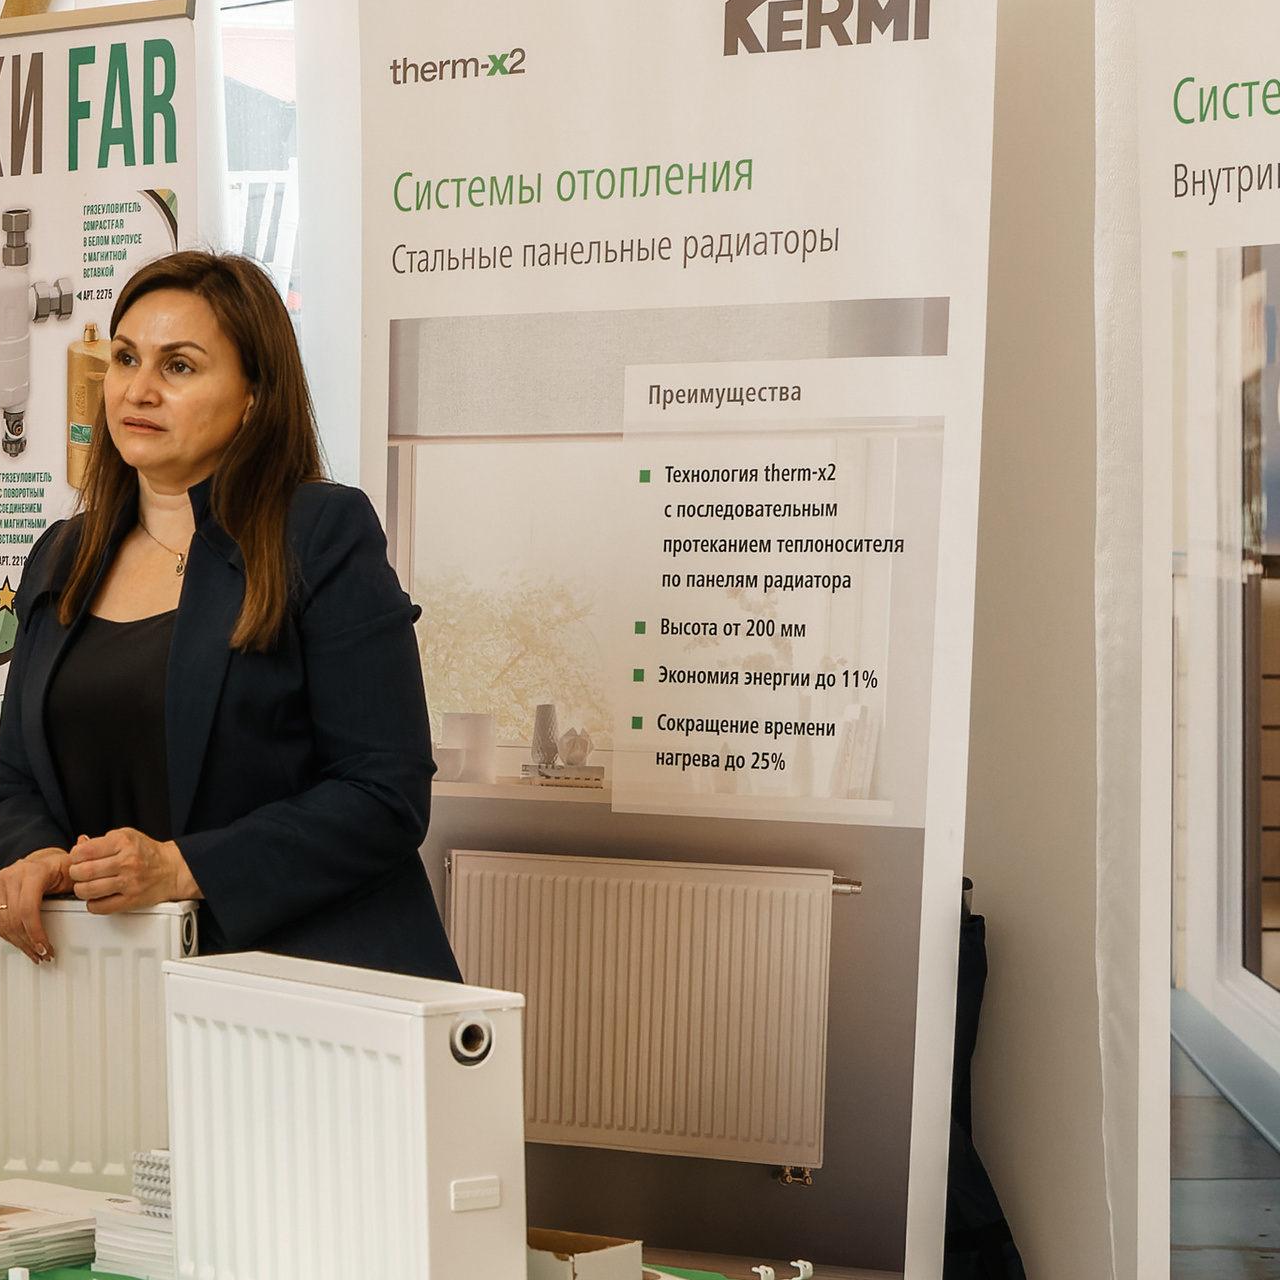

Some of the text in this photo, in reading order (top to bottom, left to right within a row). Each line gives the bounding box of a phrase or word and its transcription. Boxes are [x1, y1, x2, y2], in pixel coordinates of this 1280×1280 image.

[390, 48, 526, 85] therm-x2
[67, 38, 179, 171] FAR
[392, 158, 754, 213] Системы отопления
[1174, 160, 1280, 206] Внутри
[83, 202, 142, 216] ГРЯЗЕУЛОВИТЕЛЬ
[83, 233, 142, 247] В БЕЛОМ КОРПУСЕ
[392, 224, 839, 275] Стальные панельные радиаторы
[83, 249, 127, 263] С МАГНИТНОЙ
[83, 265, 114, 278] ВСТАВКОЙ
[83, 289, 113, 301] АРТ. 2275
[648, 383, 802, 410] Преимущества
[665, 462, 837, 484] Технология therm-x2
[3, 487, 45, 498] ПОВОРОТНЫМ
[664, 500, 838, 519] с последовательным
[3, 518, 47, 529] МАГНИТНЫМИ
[662, 536, 905, 557] протеканием теплоносителя
[661, 572, 852, 593] по панелям радиатора
[660, 618, 807, 638] Высота от 200 мм
[658, 667, 878, 692] Экономия энергии до 11%
[657, 714, 836, 741] Сокращение времени
[655, 750, 786, 773] нагрева до 25%
